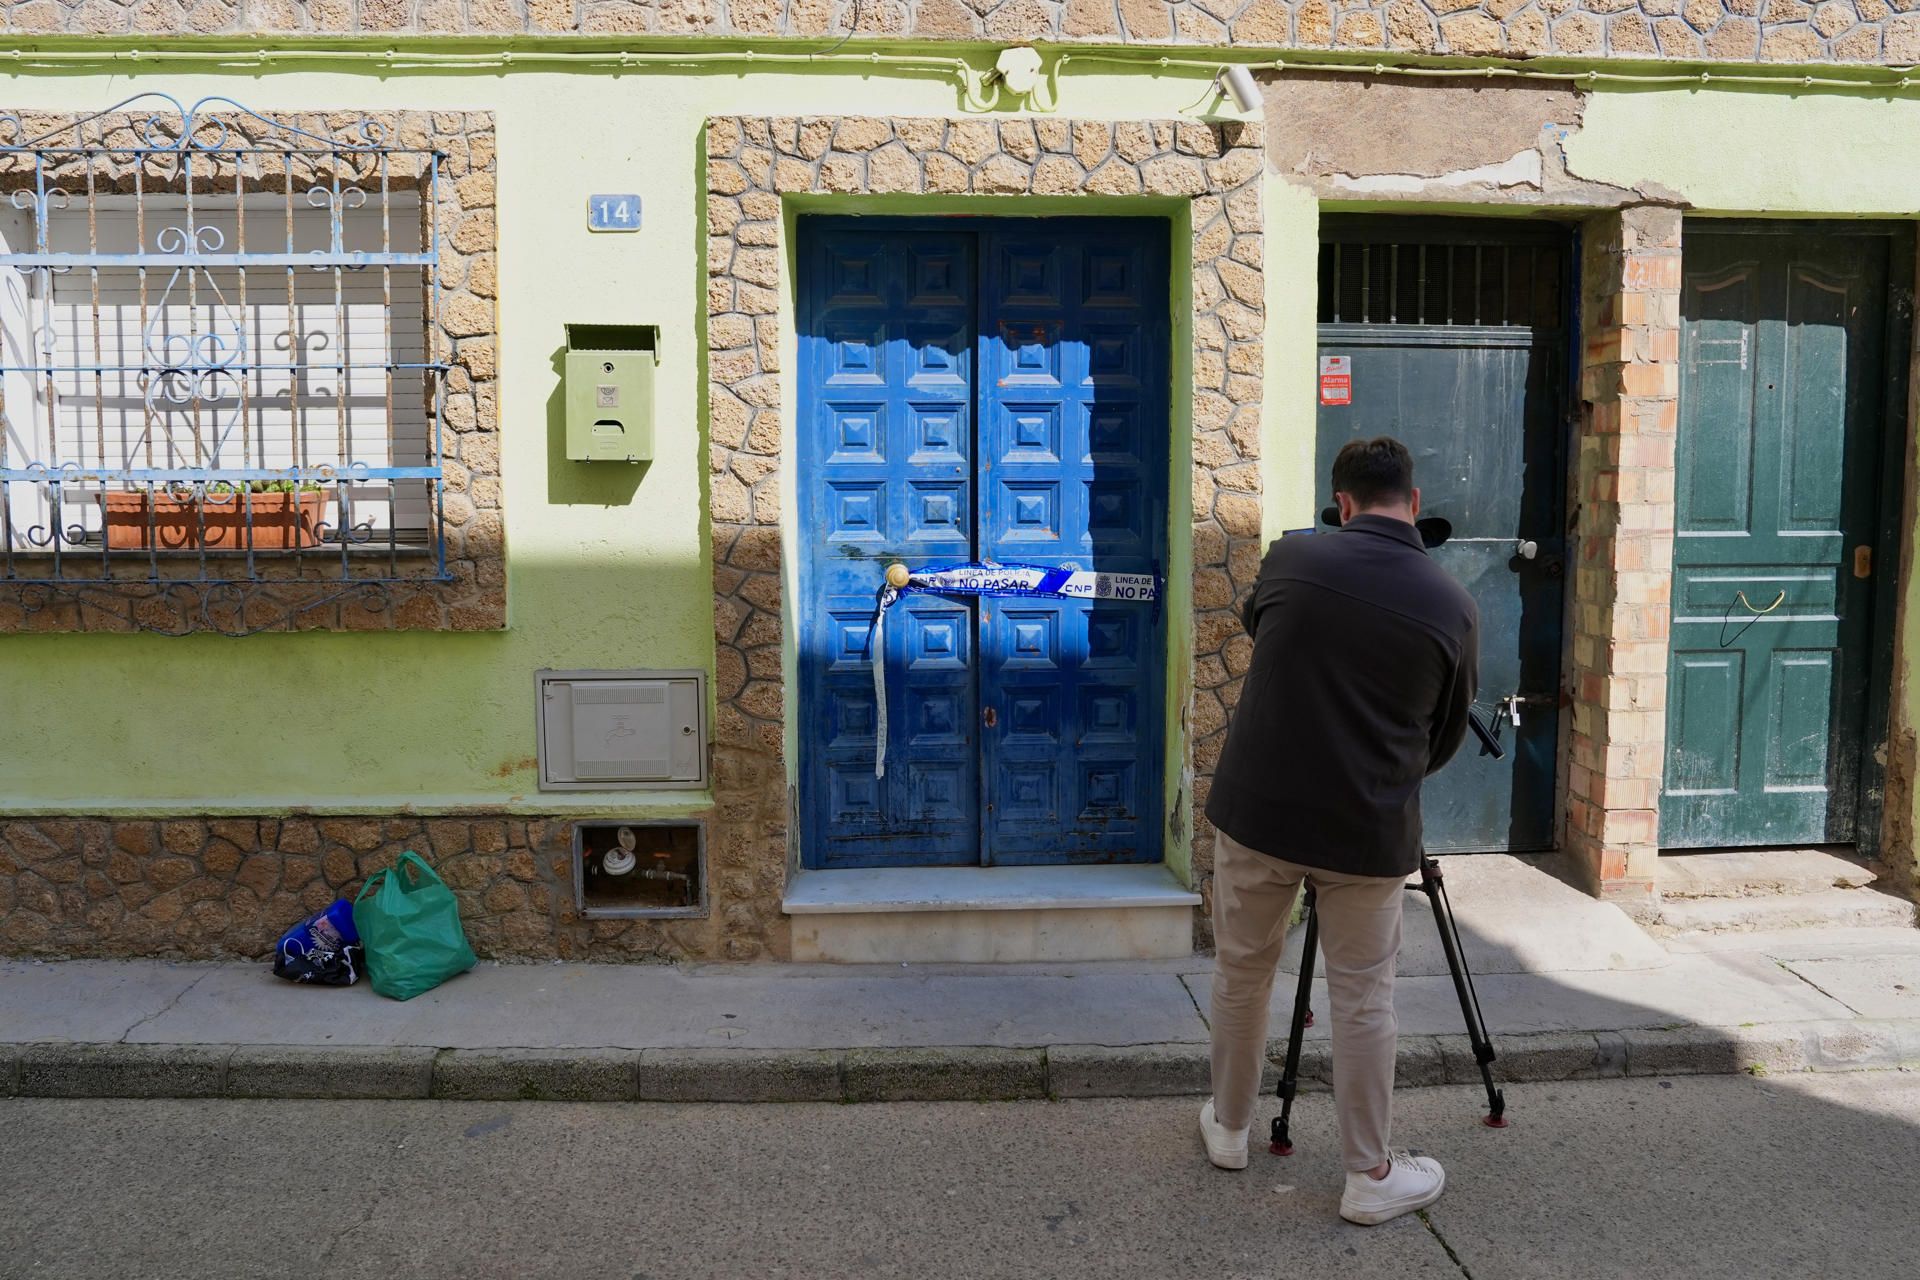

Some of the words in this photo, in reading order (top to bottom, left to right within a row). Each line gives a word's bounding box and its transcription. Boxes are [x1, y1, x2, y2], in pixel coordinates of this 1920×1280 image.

[600, 200, 630, 223] 14
[959, 578, 979, 589] NO
[983, 578, 1029, 590] PASAR
[1115, 576, 1139, 585] LINEA
[1141, 577, 1152, 585] DE
[1064, 584, 1092, 593] CNP
[1115, 586, 1136, 598] NO
